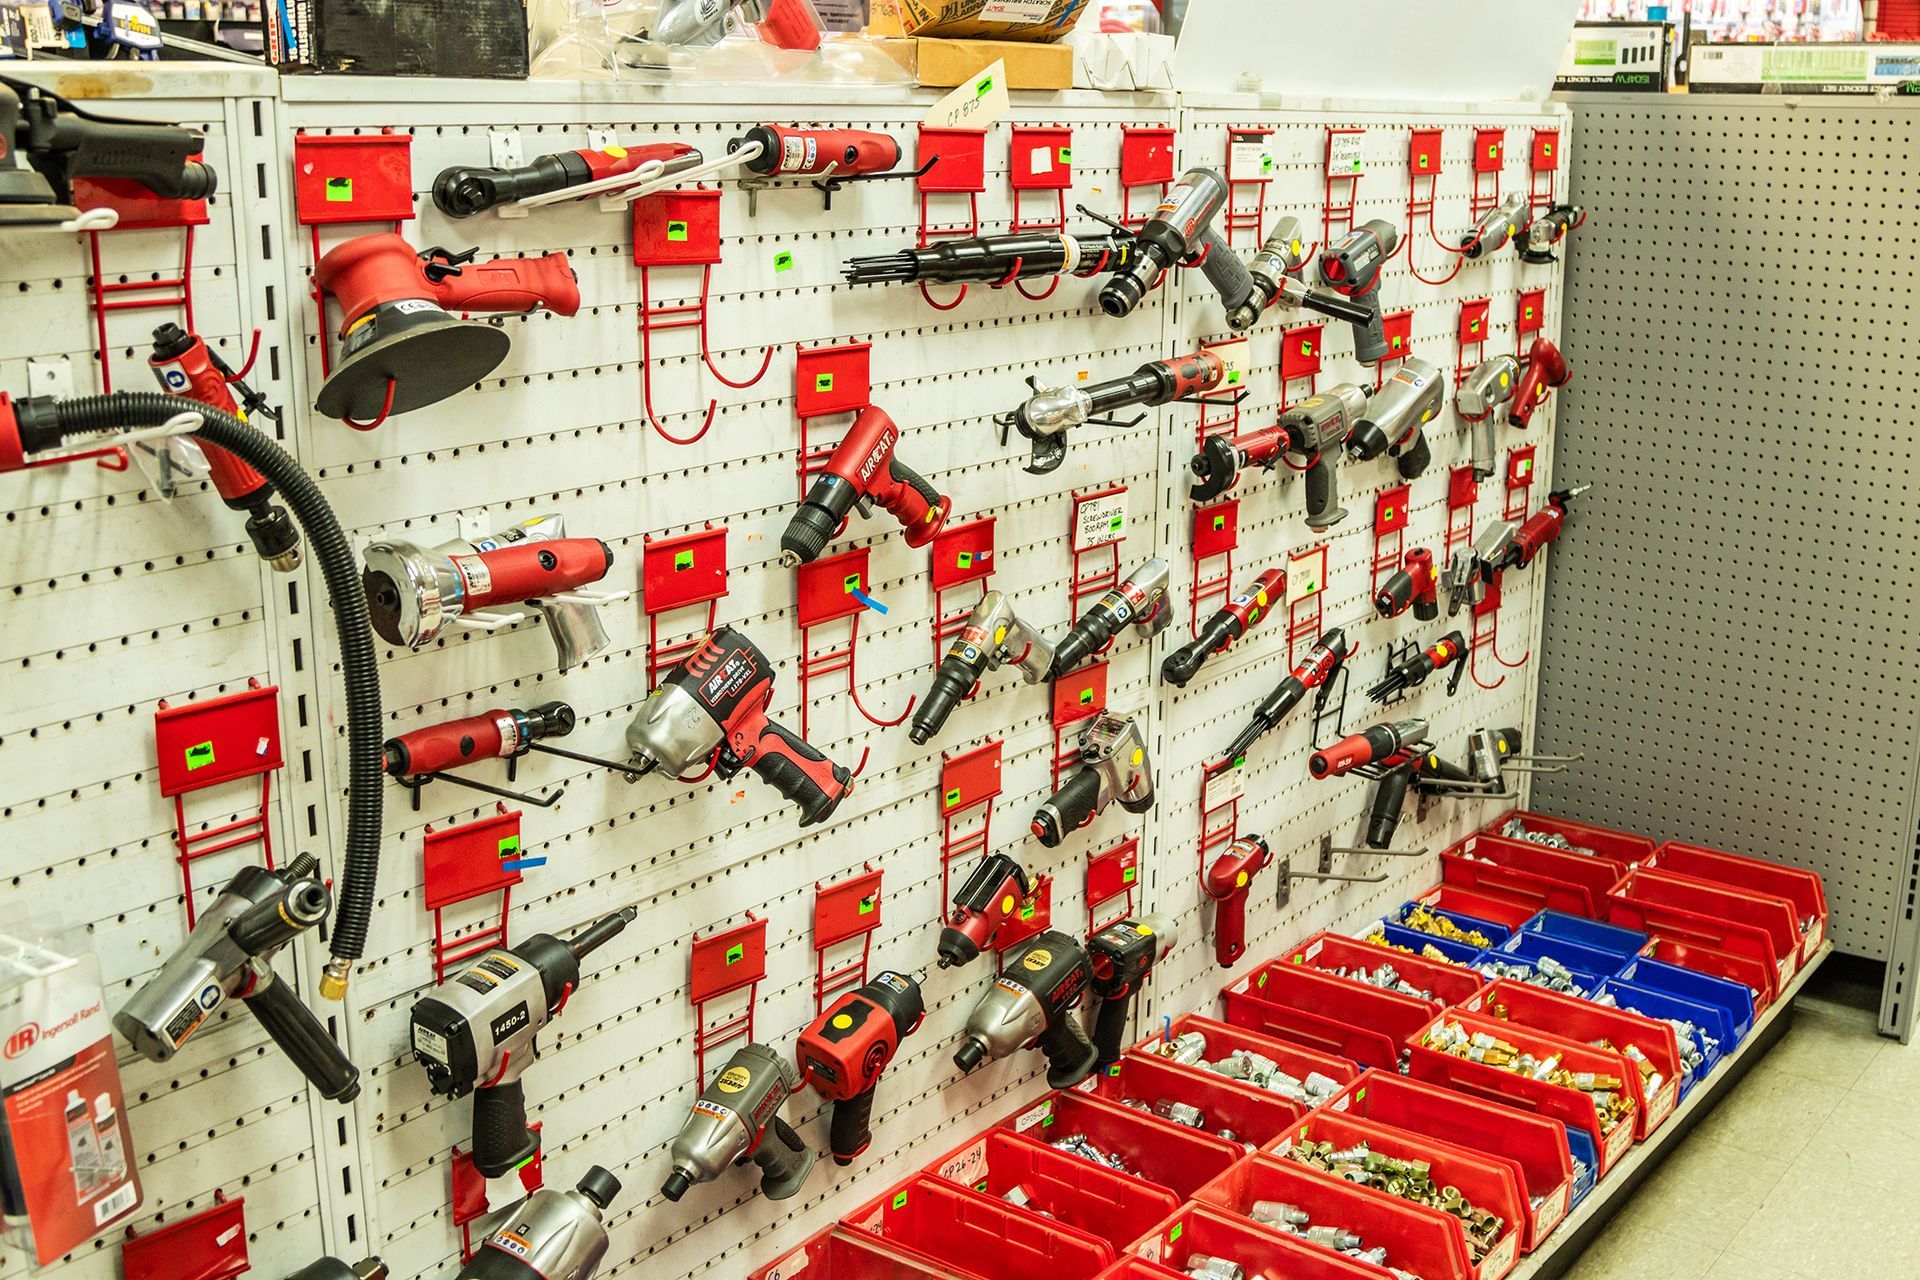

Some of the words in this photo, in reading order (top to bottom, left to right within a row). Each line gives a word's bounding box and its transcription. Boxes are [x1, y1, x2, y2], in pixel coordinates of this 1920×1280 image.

[297, 2, 310, 64] POLISHING
[962, 97, 981, 118] 875
[860, 429, 895, 483] AIRCAT
[708, 658, 736, 695] AIRCAT
[42, 1012, 79, 1040] Ingersoll
[80, 1001, 101, 1020] Rand
[494, 1010, 526, 1036] 1450-2
